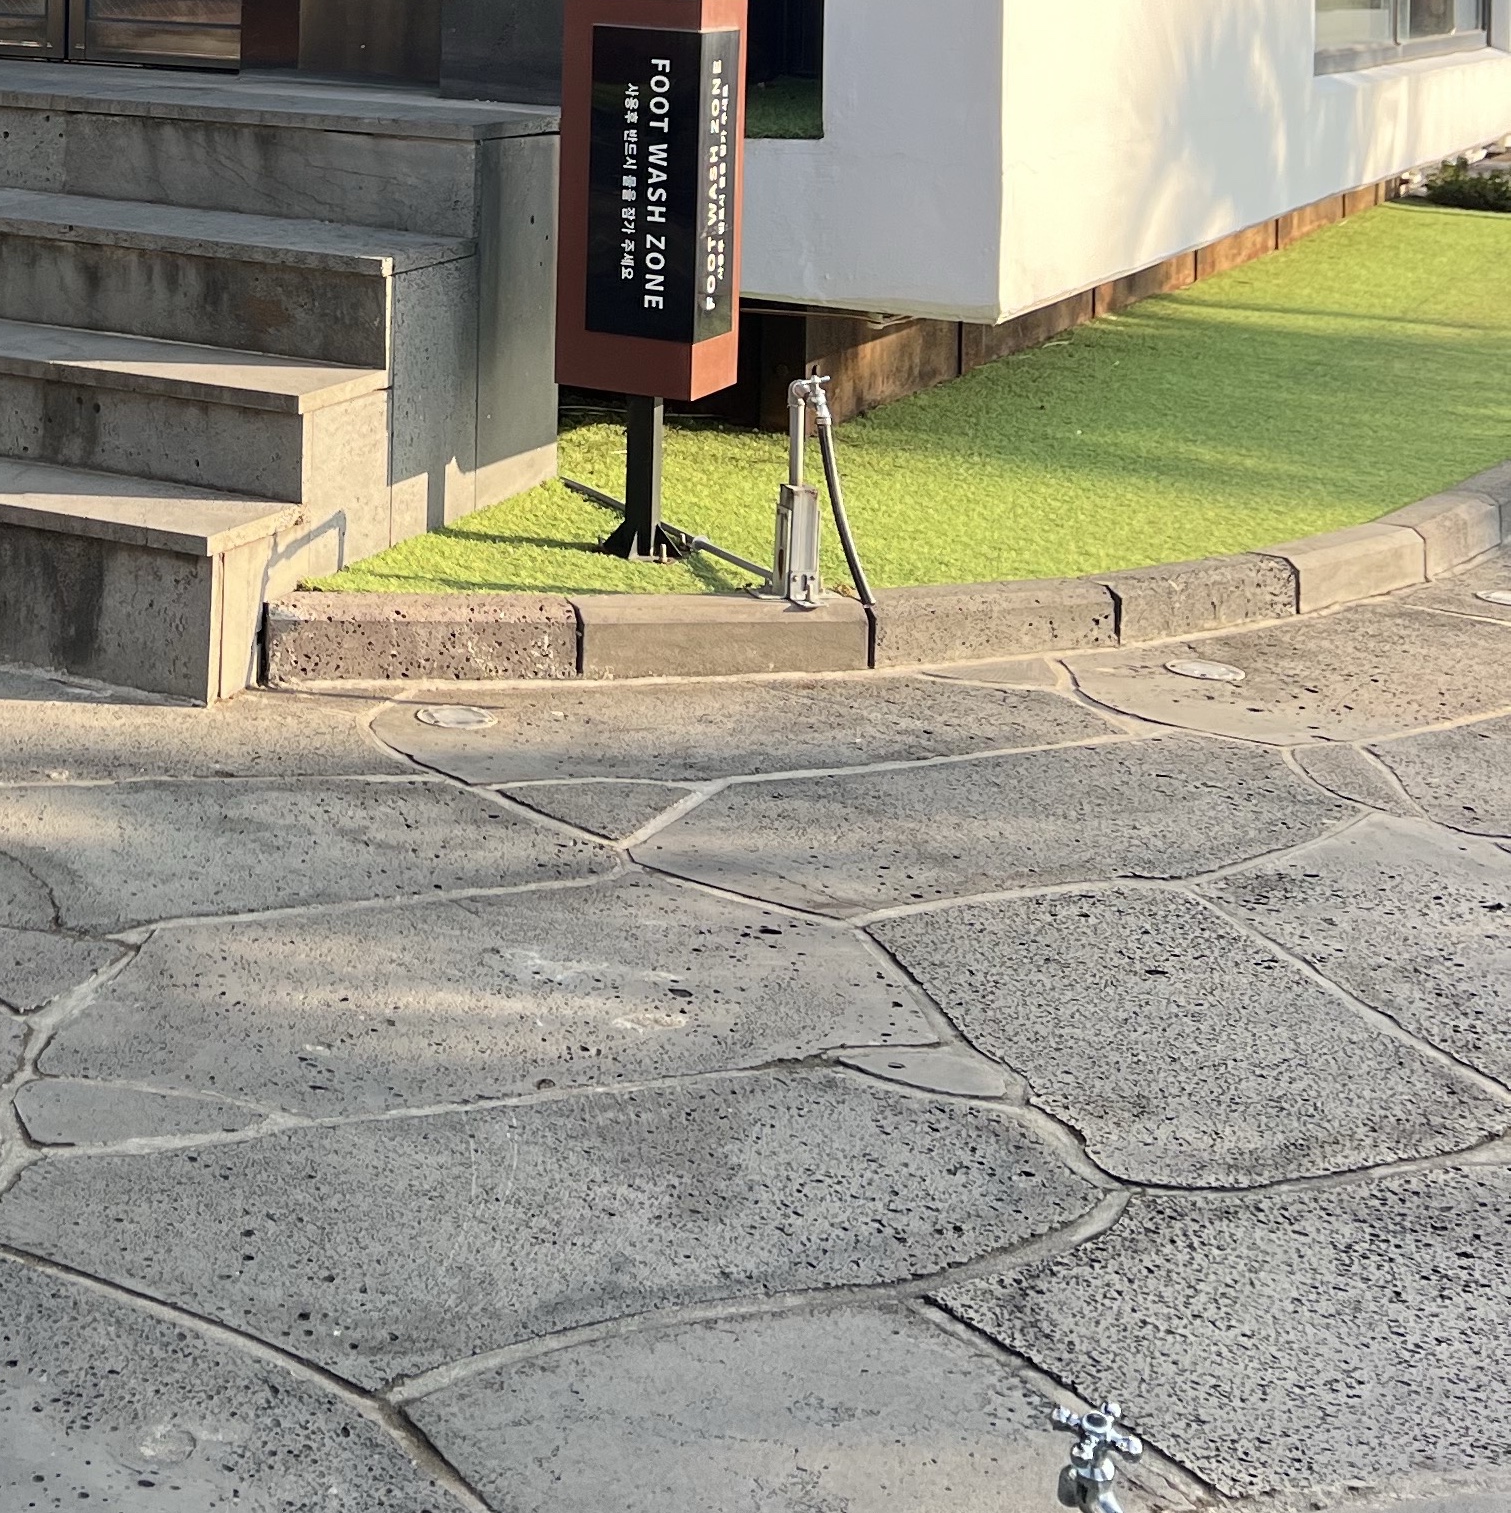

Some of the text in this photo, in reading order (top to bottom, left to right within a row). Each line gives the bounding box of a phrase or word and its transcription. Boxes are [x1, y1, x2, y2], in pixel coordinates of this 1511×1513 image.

[624, 82, 639, 124] 사용후
[623, 129, 638, 170] 반드시
[643, 58, 670, 310] FOOT WASH ZONE
[706, 58, 723, 311] FOOT WASH ZONE
[621, 206, 636, 235] 잠가
[620, 238, 635, 280] 주세요
